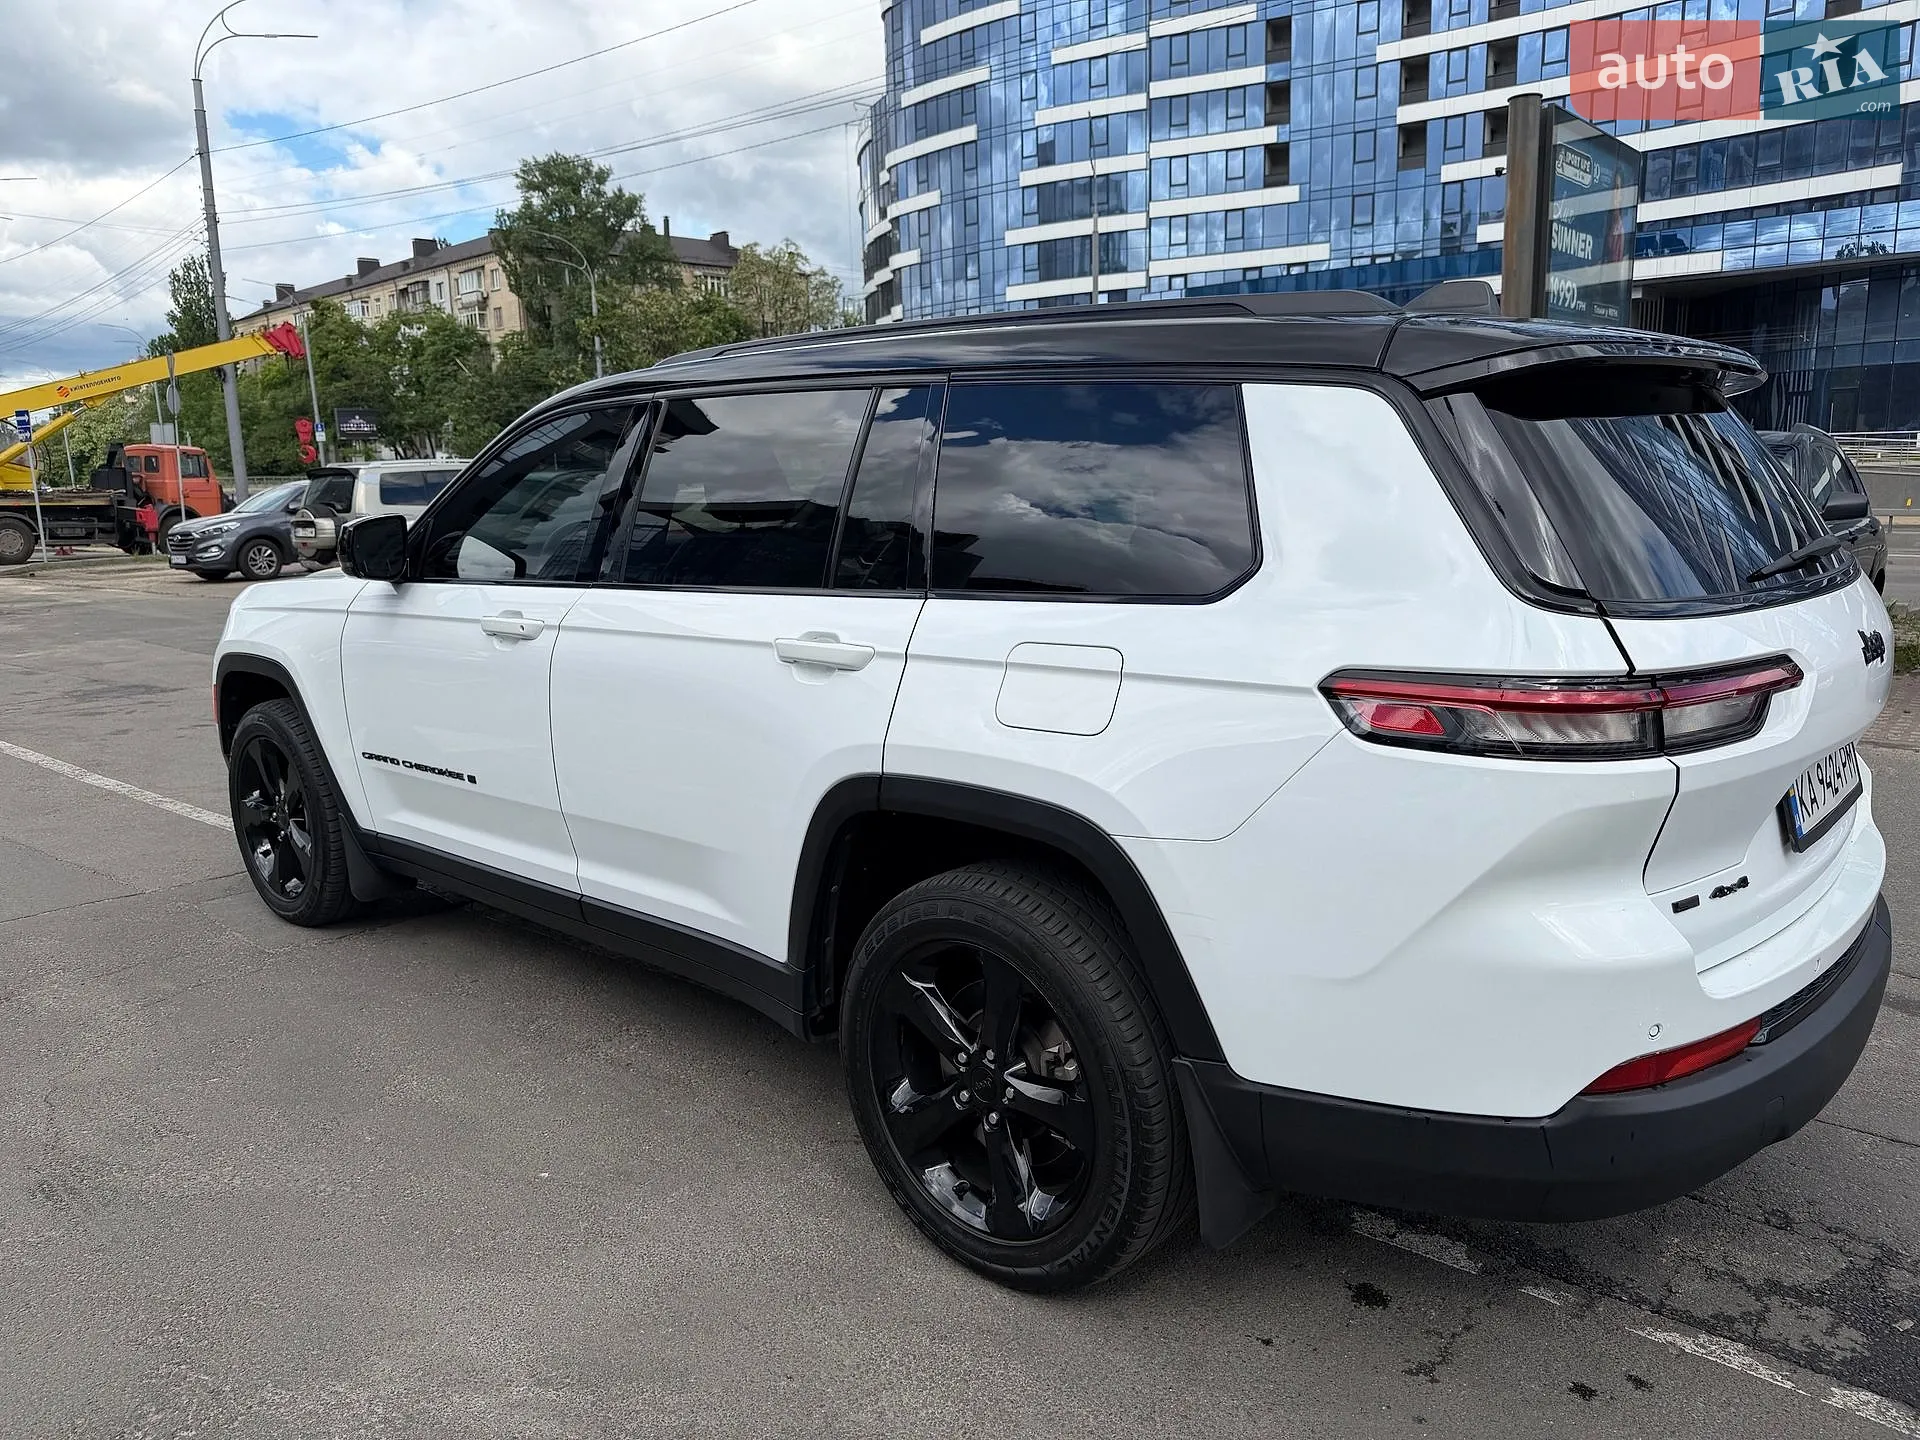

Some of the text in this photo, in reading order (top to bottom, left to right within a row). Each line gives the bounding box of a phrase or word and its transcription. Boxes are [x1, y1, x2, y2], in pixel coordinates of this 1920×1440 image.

[1551, 222, 1593, 260] SUMMER
[361, 751, 400, 766] GRAND
[401, 760, 466, 781] CHEROKEE
[1795, 771, 1819, 823] KA
[1816, 751, 1844, 806] 9424
